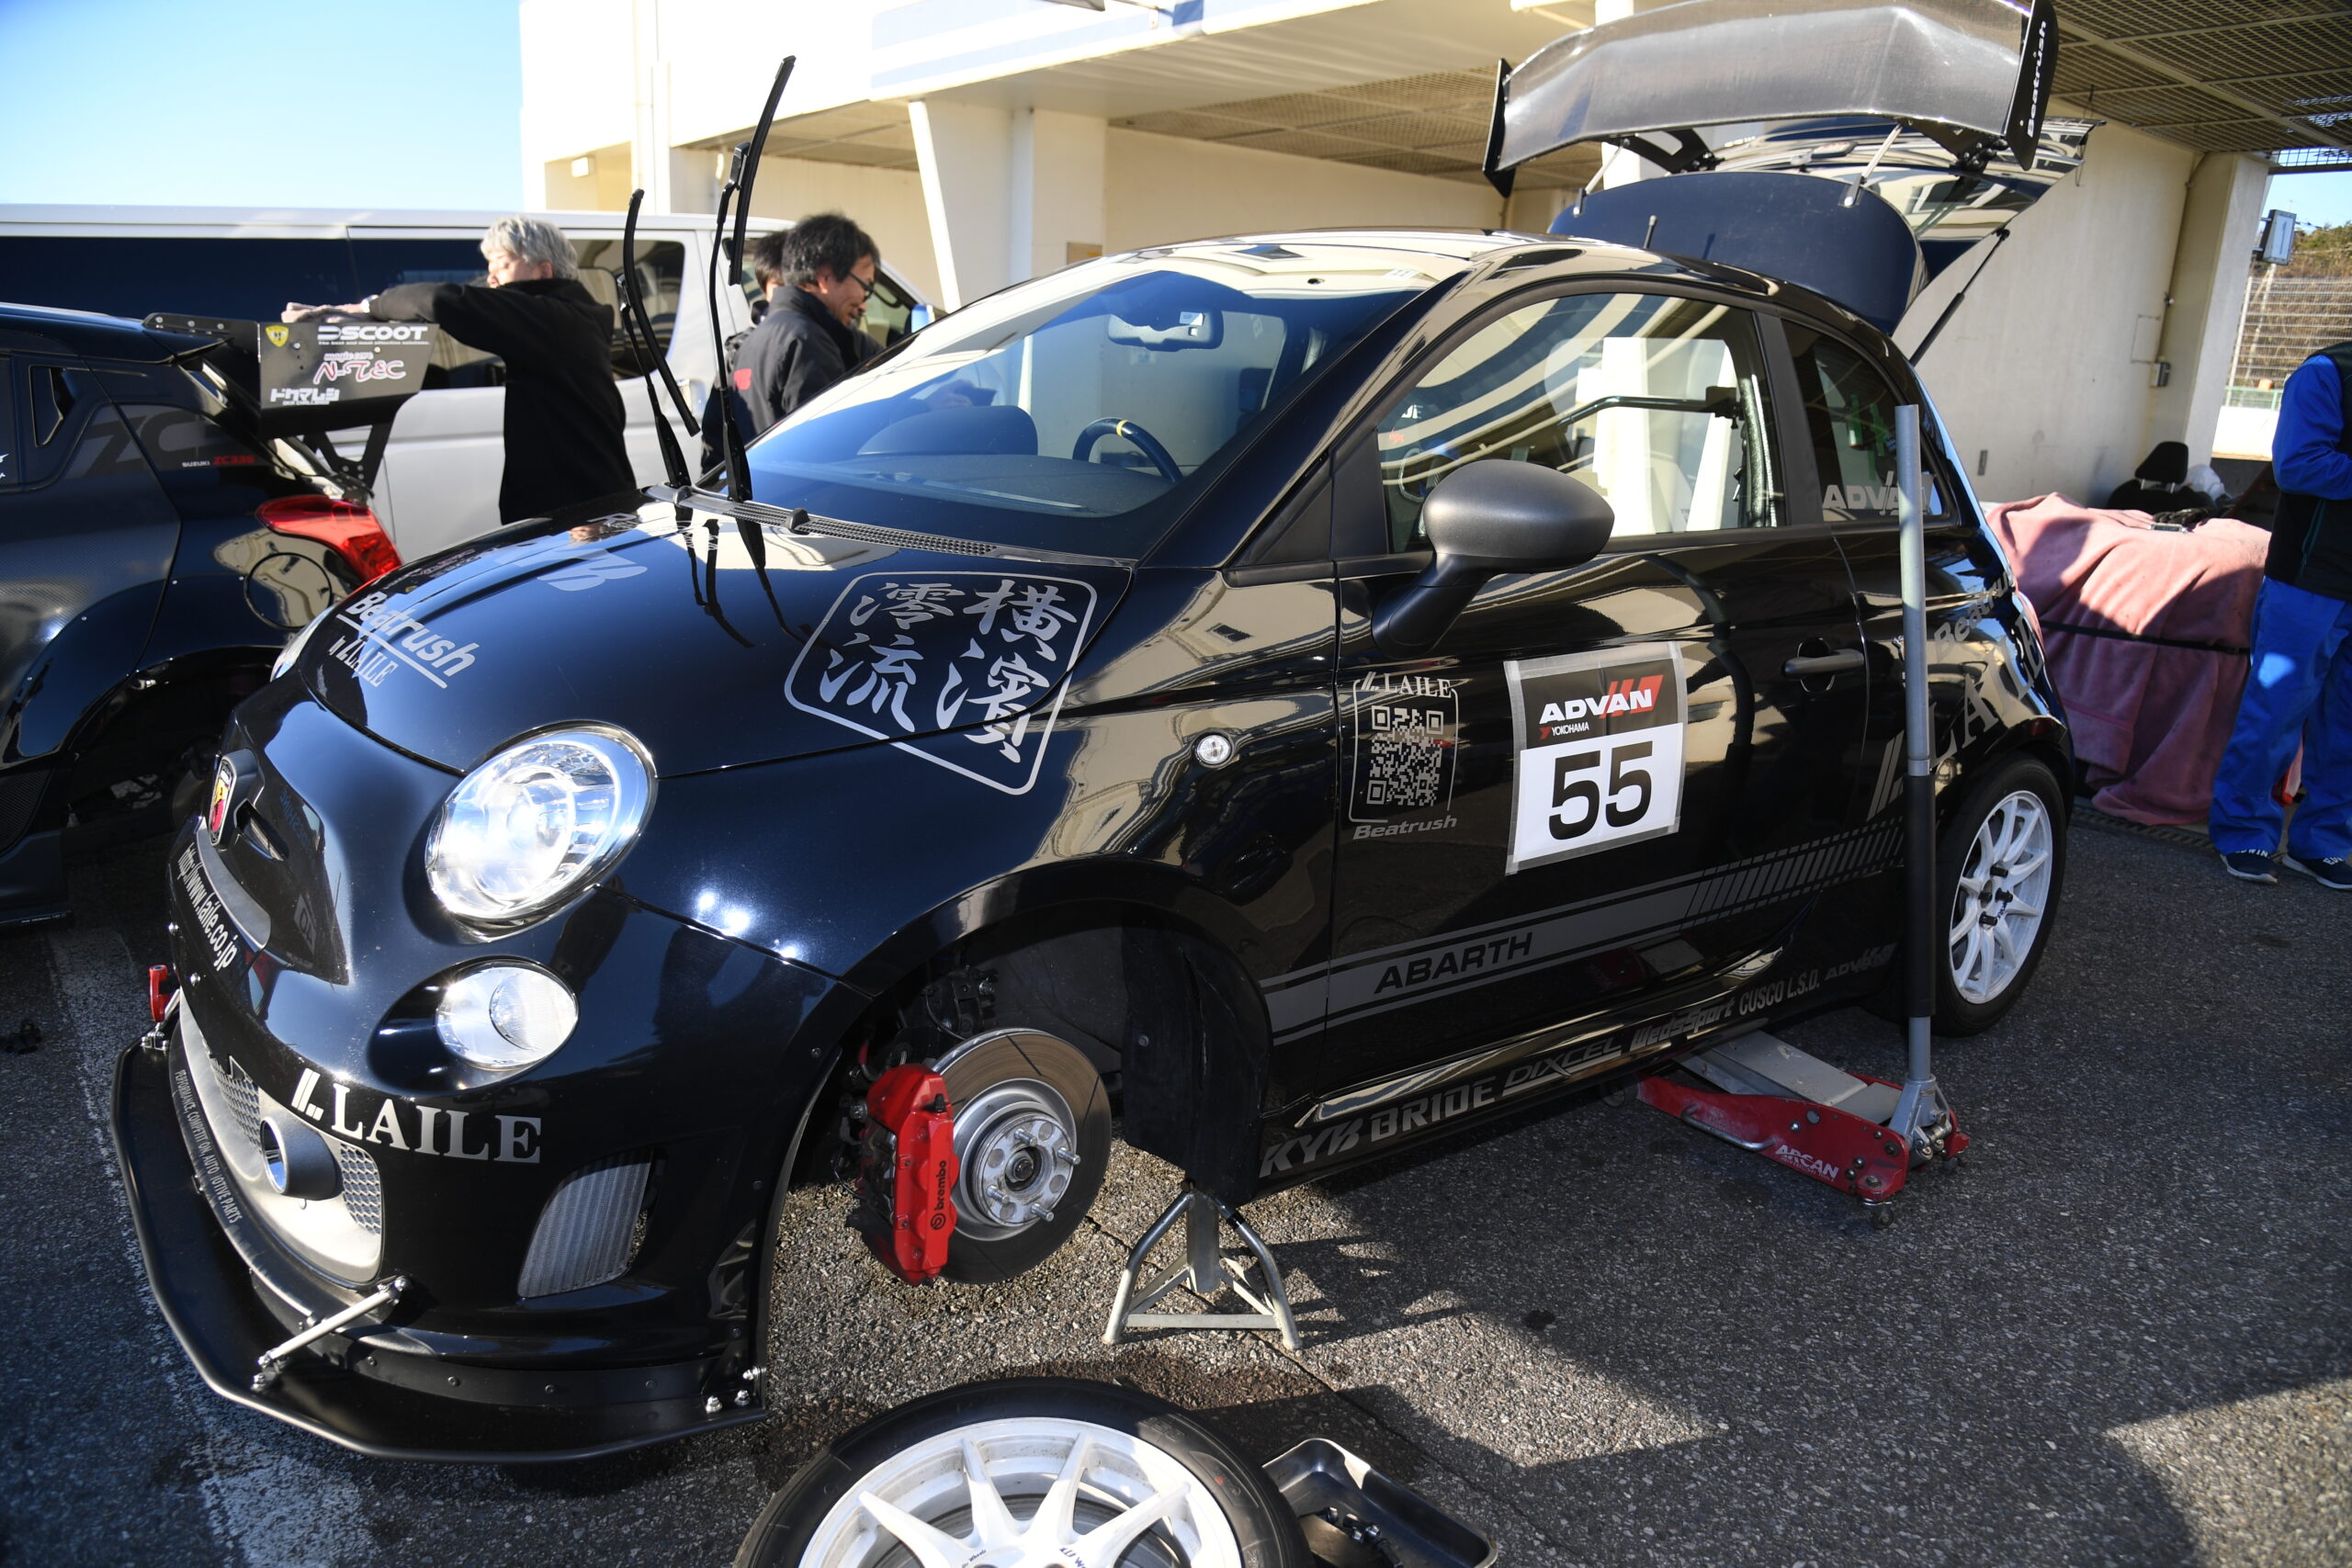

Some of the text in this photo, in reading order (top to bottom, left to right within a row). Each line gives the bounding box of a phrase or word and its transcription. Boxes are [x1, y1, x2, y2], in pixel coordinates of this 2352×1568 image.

[2027, 20, 2047, 138] Beatrush
[345, 591, 480, 677] Beatrush
[1384, 672, 1452, 698] LAILE
[1539, 688, 1653, 725] ADVAN
[1551, 722, 1589, 737] YOKOHAMA
[1548, 740, 1654, 840] 55
[1352, 815, 1458, 840] Beatrush
[177, 841, 239, 972] http://www.laile.co.jp
[1374, 931, 1533, 995] ABARTH
[1259, 1117, 1364, 1179] KYB
[1370, 1076, 1497, 1144] BRIDE
[1505, 1036, 1623, 1088] DIXCEL
[1630, 996, 1736, 1053] WedsSport
[1738, 979, 1785, 1017] CUSCO
[1787, 969, 1820, 998] L.S.D.
[187, 1111, 213, 1157] COMPETITON,
[331, 1081, 542, 1165] LAILE
[933, 1160, 946, 1212] brembo
[1775, 1145, 1839, 1179] ARCAN
